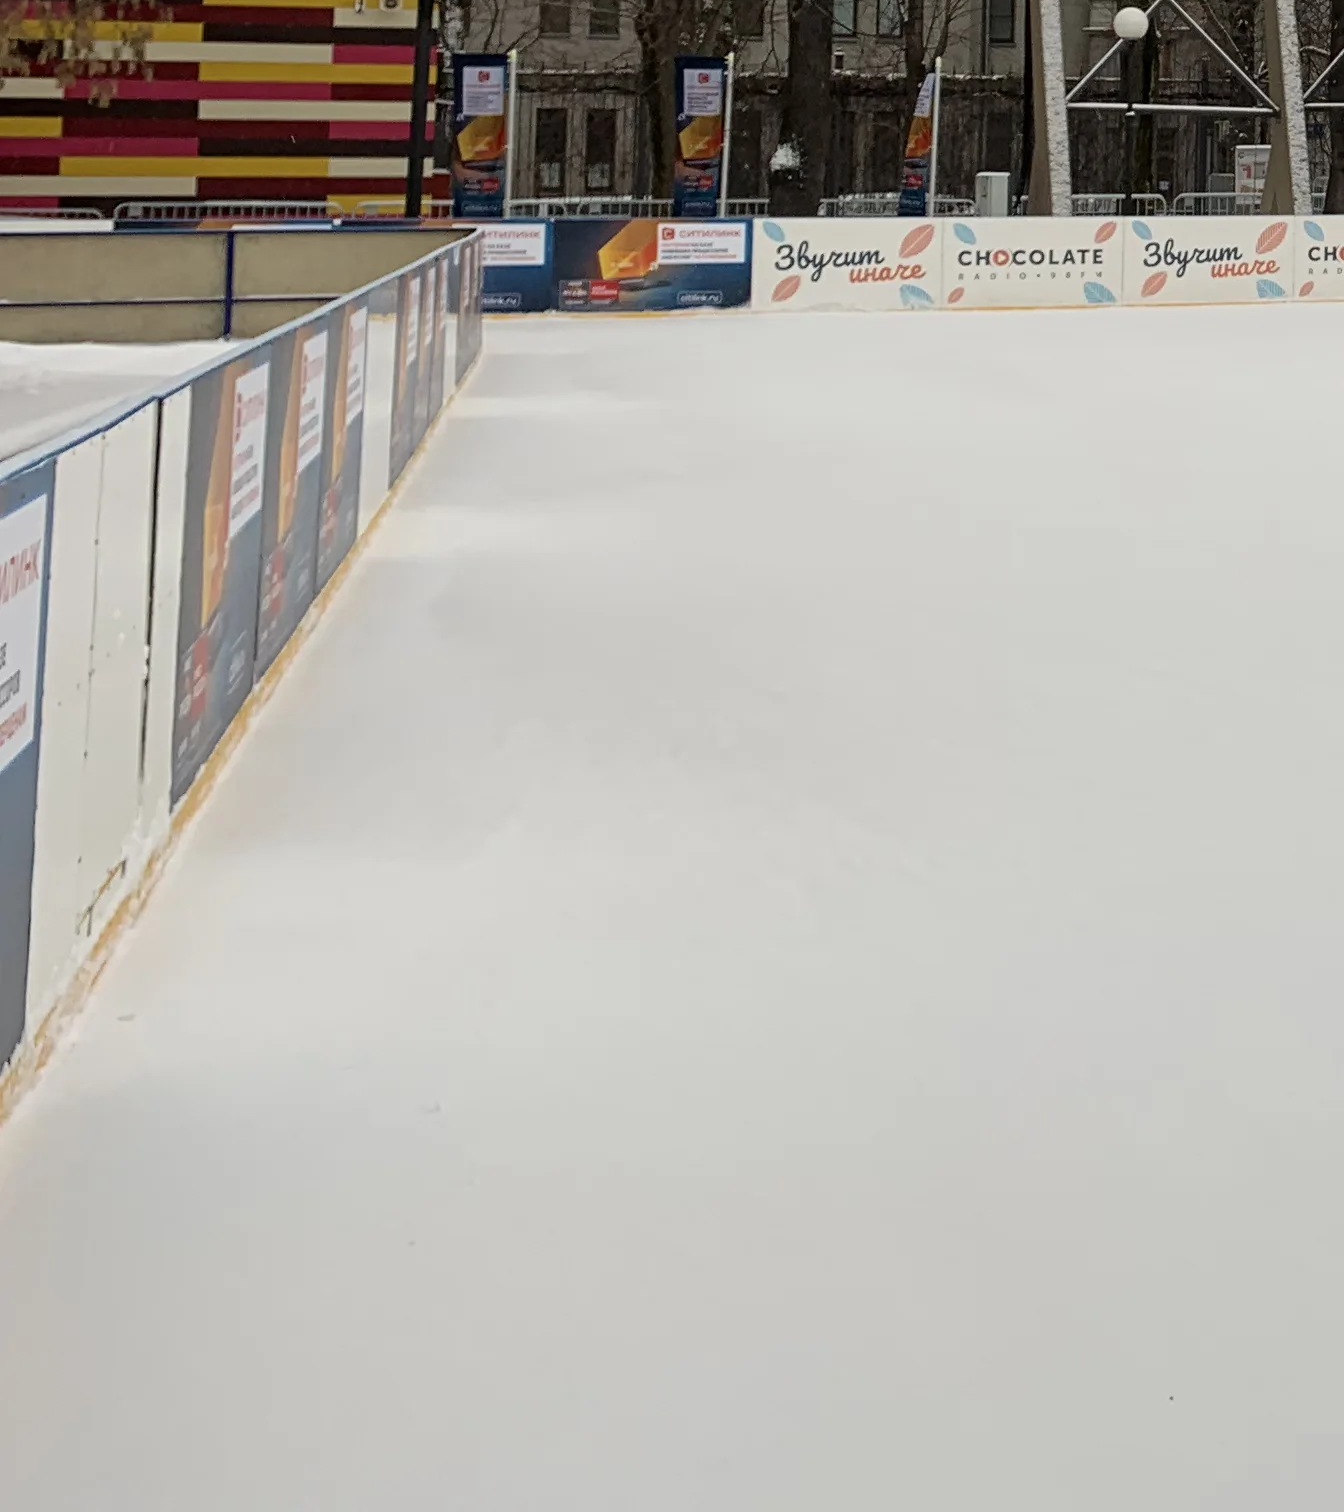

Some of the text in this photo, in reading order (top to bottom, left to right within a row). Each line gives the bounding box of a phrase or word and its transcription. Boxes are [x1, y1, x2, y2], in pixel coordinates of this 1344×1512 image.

[679, 229, 741, 239] СИТИЛИНК
[774, 240, 885, 282] Звучит
[957, 249, 1103, 266] CHOCOLATE
[1143, 238, 1242, 278] Звучит
[849, 263, 926, 283] иначе
[1211, 259, 1280, 278] иначе
